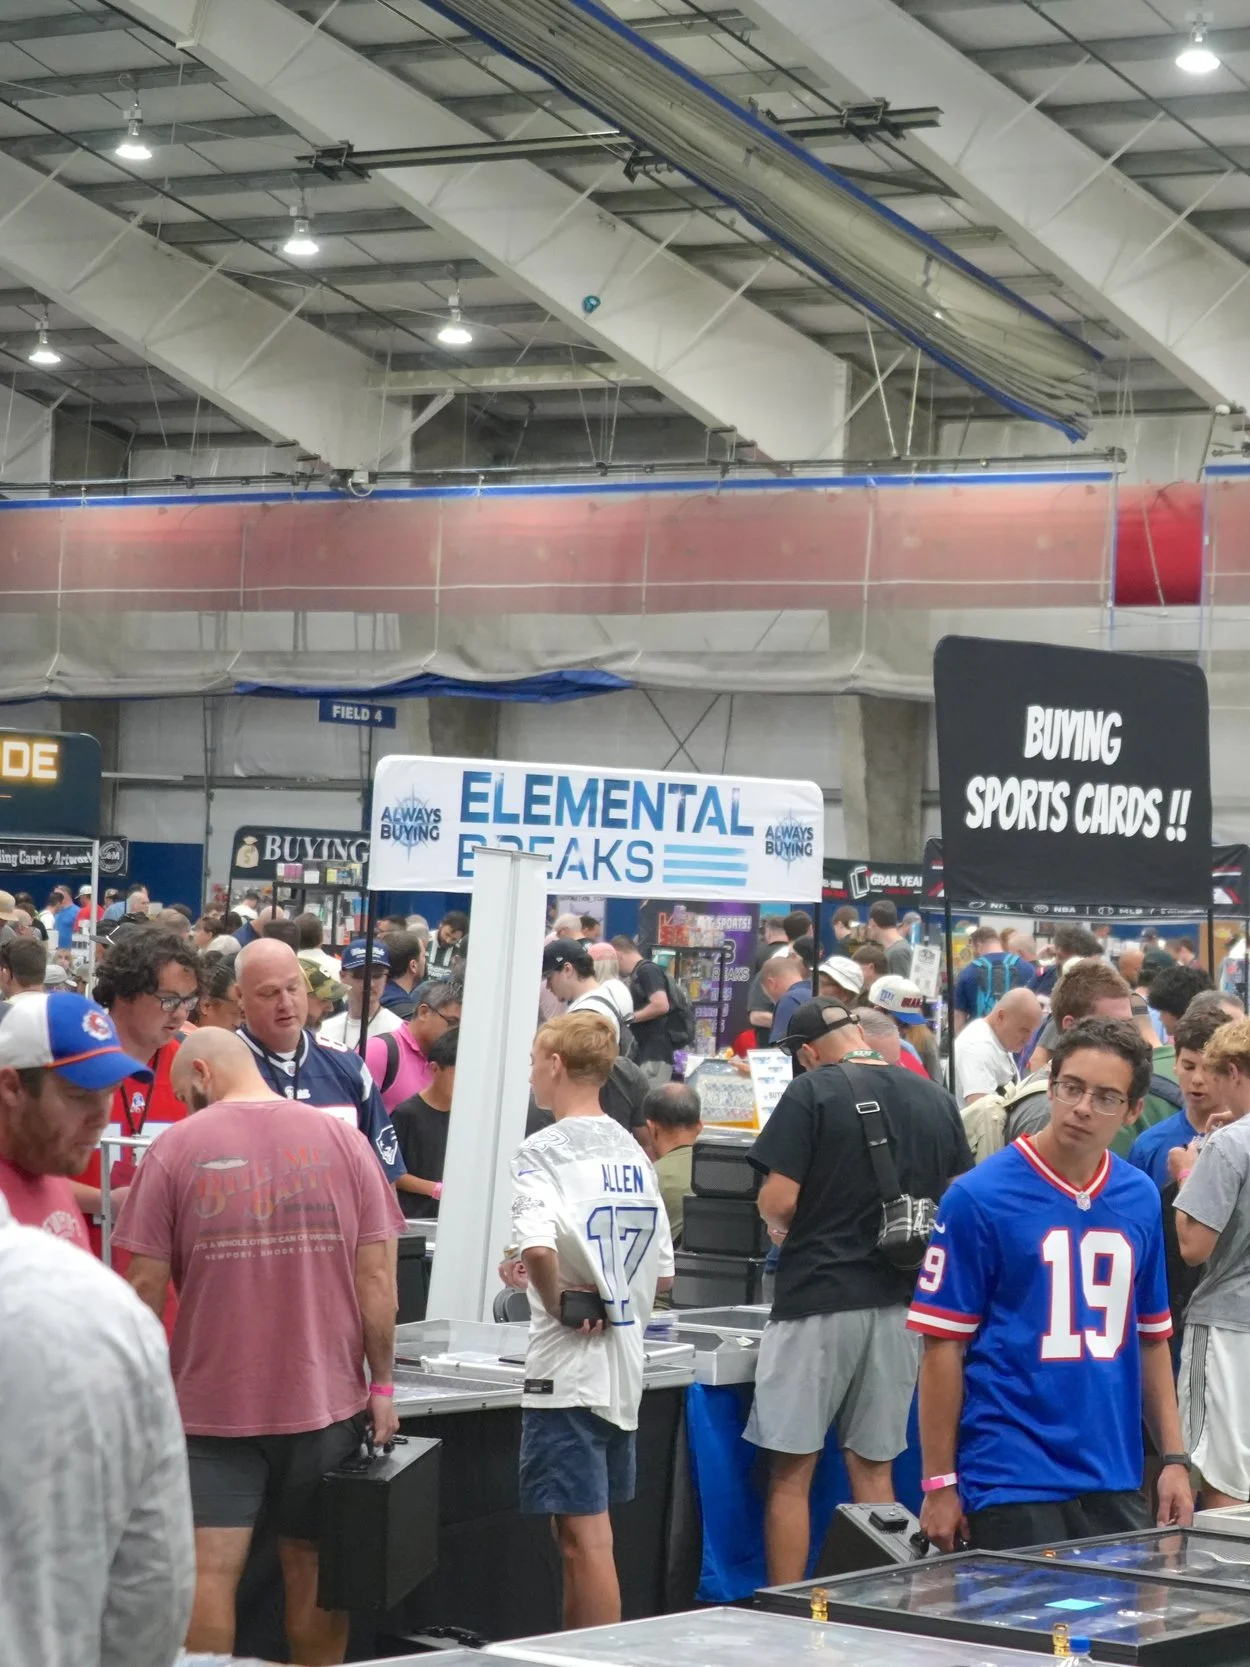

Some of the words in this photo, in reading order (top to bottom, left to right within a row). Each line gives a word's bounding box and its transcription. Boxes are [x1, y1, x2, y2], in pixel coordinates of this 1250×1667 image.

[332, 704, 370, 721] FIELD
[374, 710, 383, 722] 4
[1024, 705, 1122, 765] BUYING
[2, 740, 58, 779] DE
[380, 806, 442, 824] ALWAYS
[460, 771, 754, 836] ELEMENTAL
[965, 776, 1070, 832] SPORTS
[1074, 783, 1163, 838] CARDS
[1165, 790, 1192, 842] !!
[380, 823, 440, 841] BUYING
[765, 825, 814, 841] ALWAYS
[20, 850, 46, 865] Cards
[264, 835, 370, 863] BUYING
[765, 841, 813, 857] BUYING
[870, 875, 899, 887] GRAIL
[990, 902, 1010, 910] NFL
[1053, 904, 1077, 914] NBA
[1119, 907, 1144, 916] MLB
[601, 1163, 644, 1193] ALLEN
[217, 1239, 250, 1249] WHOLE
[250, 1237, 277, 1247] OTHER
[278, 1235, 297, 1244] CAN
[586, 1205, 658, 1326] 17
[918, 1245, 946, 1294] 9
[1040, 1226, 1136, 1362] 19
